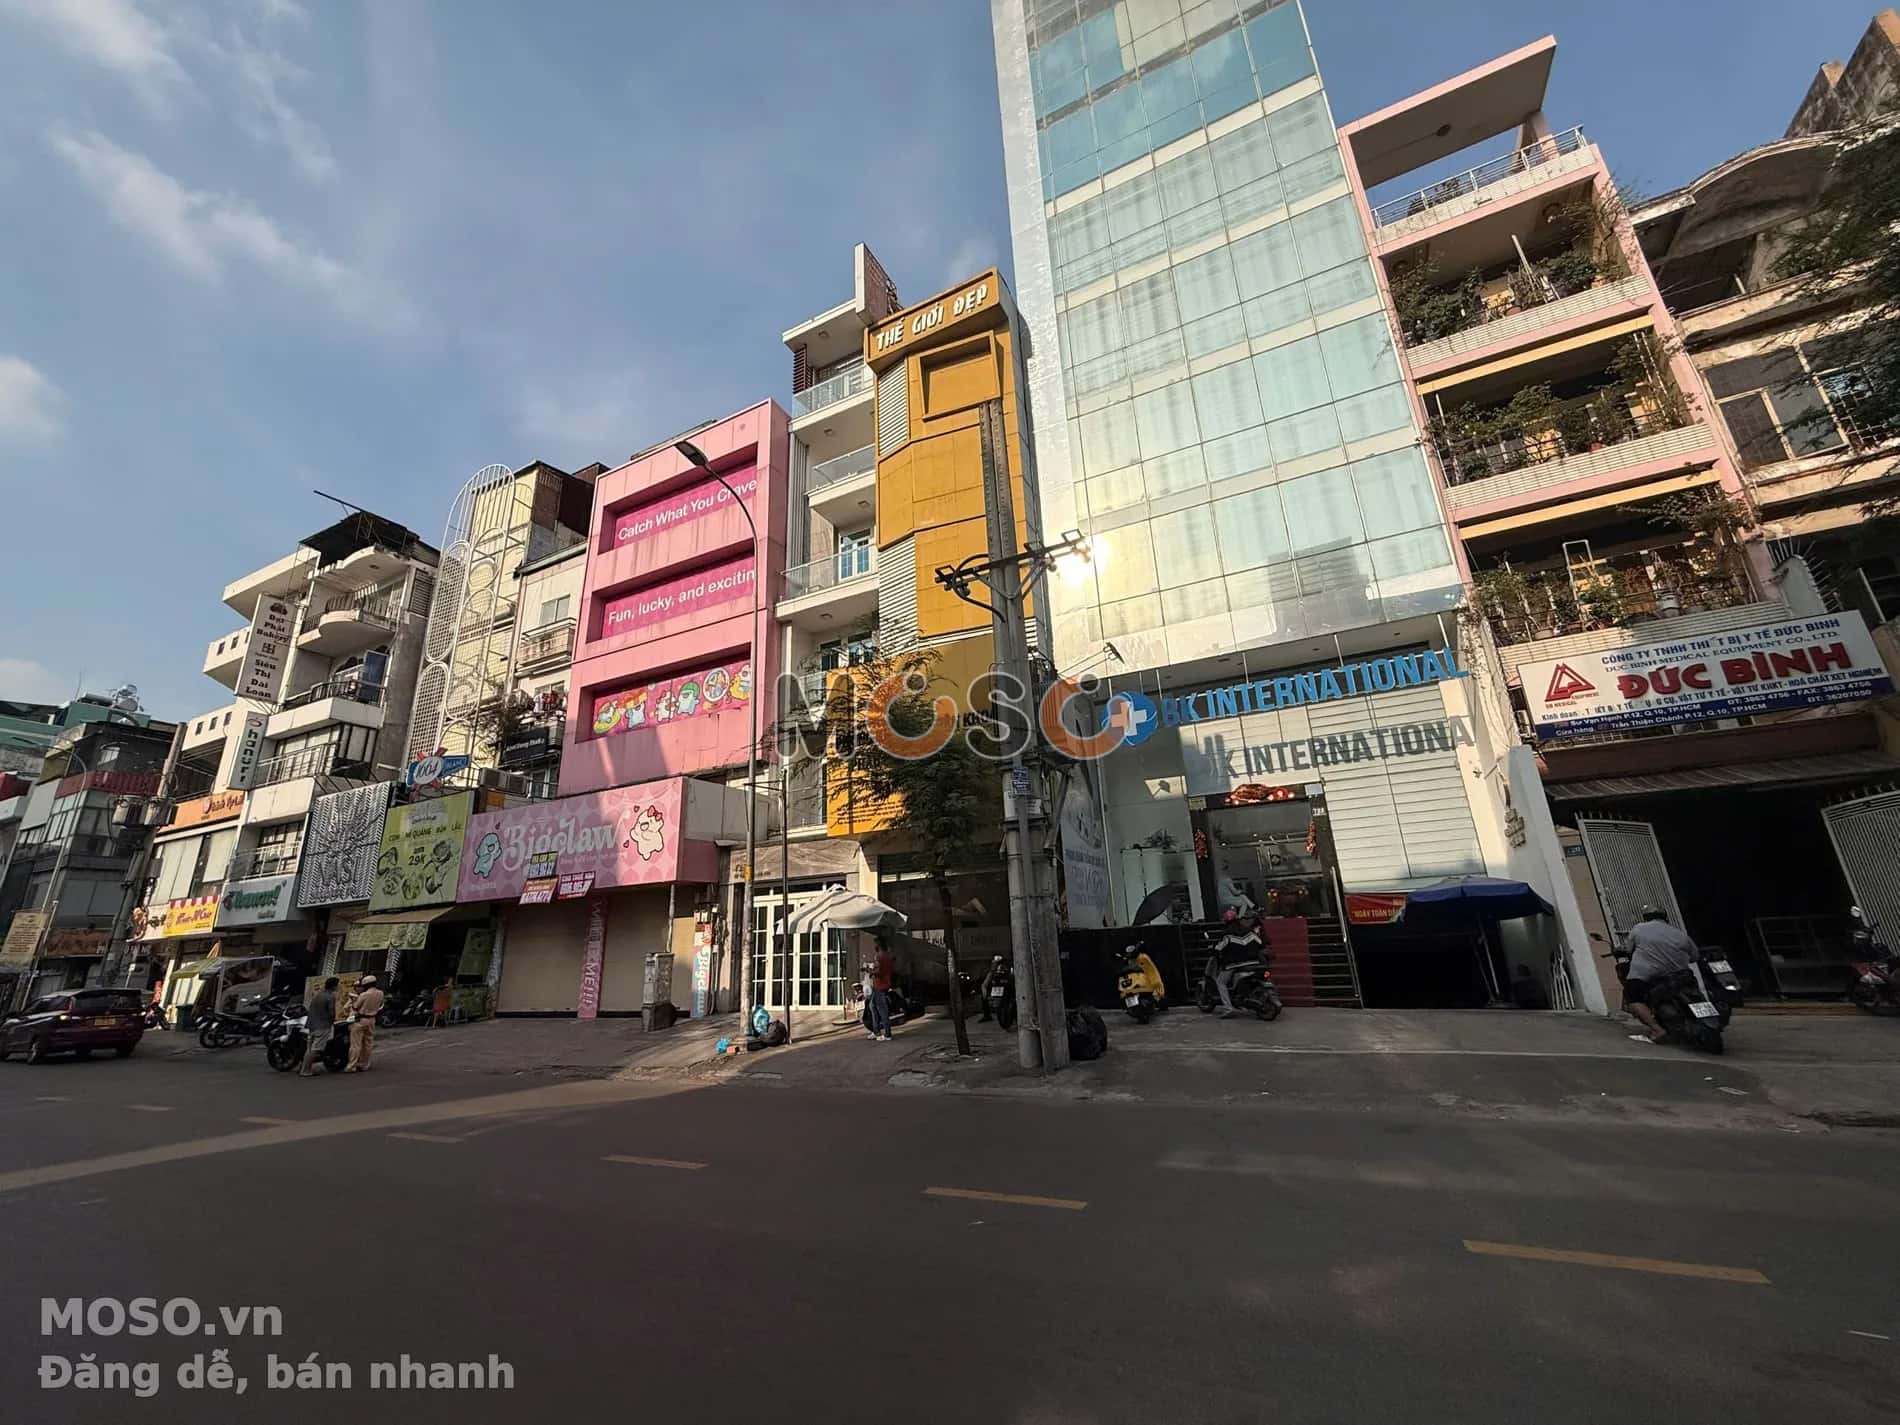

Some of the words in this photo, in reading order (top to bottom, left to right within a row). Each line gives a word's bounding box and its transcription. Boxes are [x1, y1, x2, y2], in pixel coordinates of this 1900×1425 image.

[876, 317, 905, 352] THẾ
[911, 302, 944, 335] GIỚI
[952, 284, 988, 316] ĐẸP
[618, 517, 653, 541] Catch
[655, 505, 689, 528] What
[690, 496, 715, 514] You
[716, 478, 758, 503] Crave
[607, 607, 635, 627] Fun,
[638, 590, 674, 617] lucky,
[678, 582, 705, 604] and
[707, 567, 755, 593] excitin
[1601, 652, 1634, 665] CÔNG
[1636, 649, 1651, 659] TY
[1652, 643, 1687, 657] TNHH
[1688, 636, 1725, 651] THIT
[1727, 635, 1742, 645] BỊ
[1743, 633, 1751, 642] Y
[1755, 628, 1772, 640] TẾ
[1617, 663, 1713, 700] ĐỨC
[1720, 642, 1852, 683] BÌNH
[1630, 659, 1658, 670] BINH
[1658, 651, 1711, 666] MEDICAL
[1713, 640, 1782, 657] EQUIPMENT
[1206, 648, 1470, 720] INTERNATIONAL
[1584, 716, 1602, 726] Vạn
